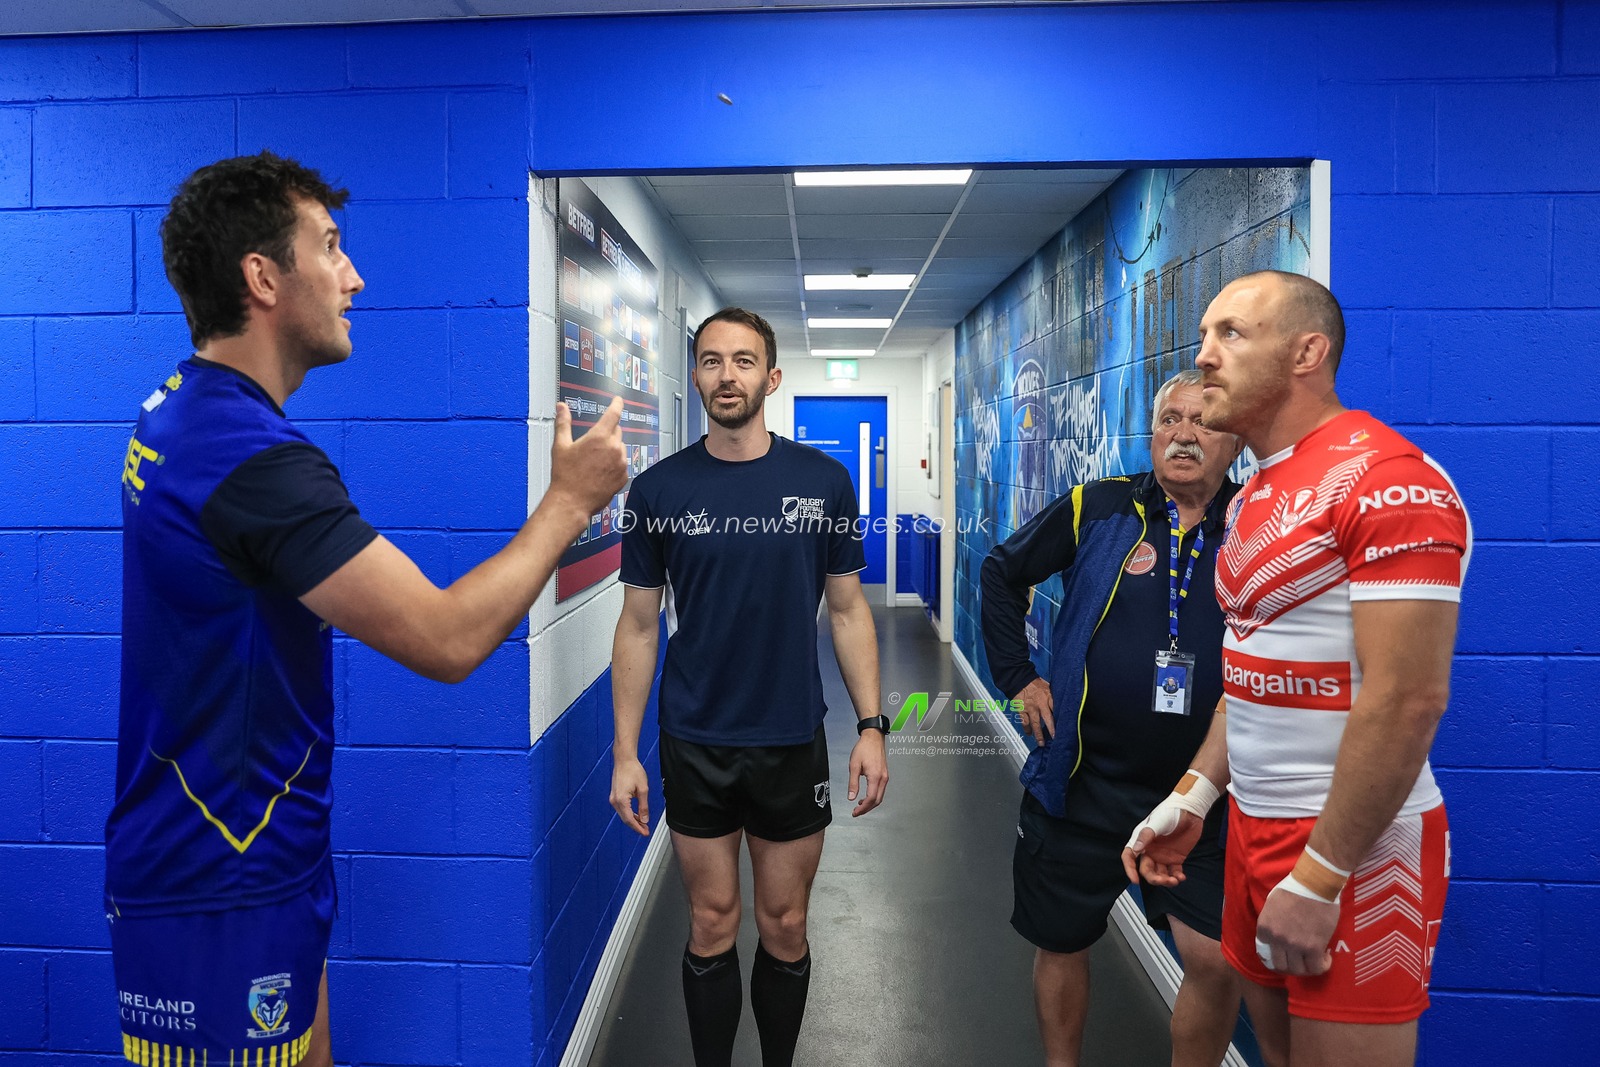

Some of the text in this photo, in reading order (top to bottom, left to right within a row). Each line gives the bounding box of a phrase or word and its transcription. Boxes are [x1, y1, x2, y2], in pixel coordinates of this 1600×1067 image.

[568, 202, 595, 243] BETFRED
[602, 233, 618, 266] BETFRED
[1018, 370, 1040, 401] WOLVES
[800, 498, 825, 507] RUGBY
[800, 512, 825, 520] LEAGUE
[687, 526, 711, 536] OXEN
[1428, 546, 1456, 554] Passion
[1224, 657, 1340, 697] bargains
[252, 973, 291, 985] WARRINGTON
[119, 990, 195, 1014] IRELAND
[121, 1006, 197, 1030] CITORS
